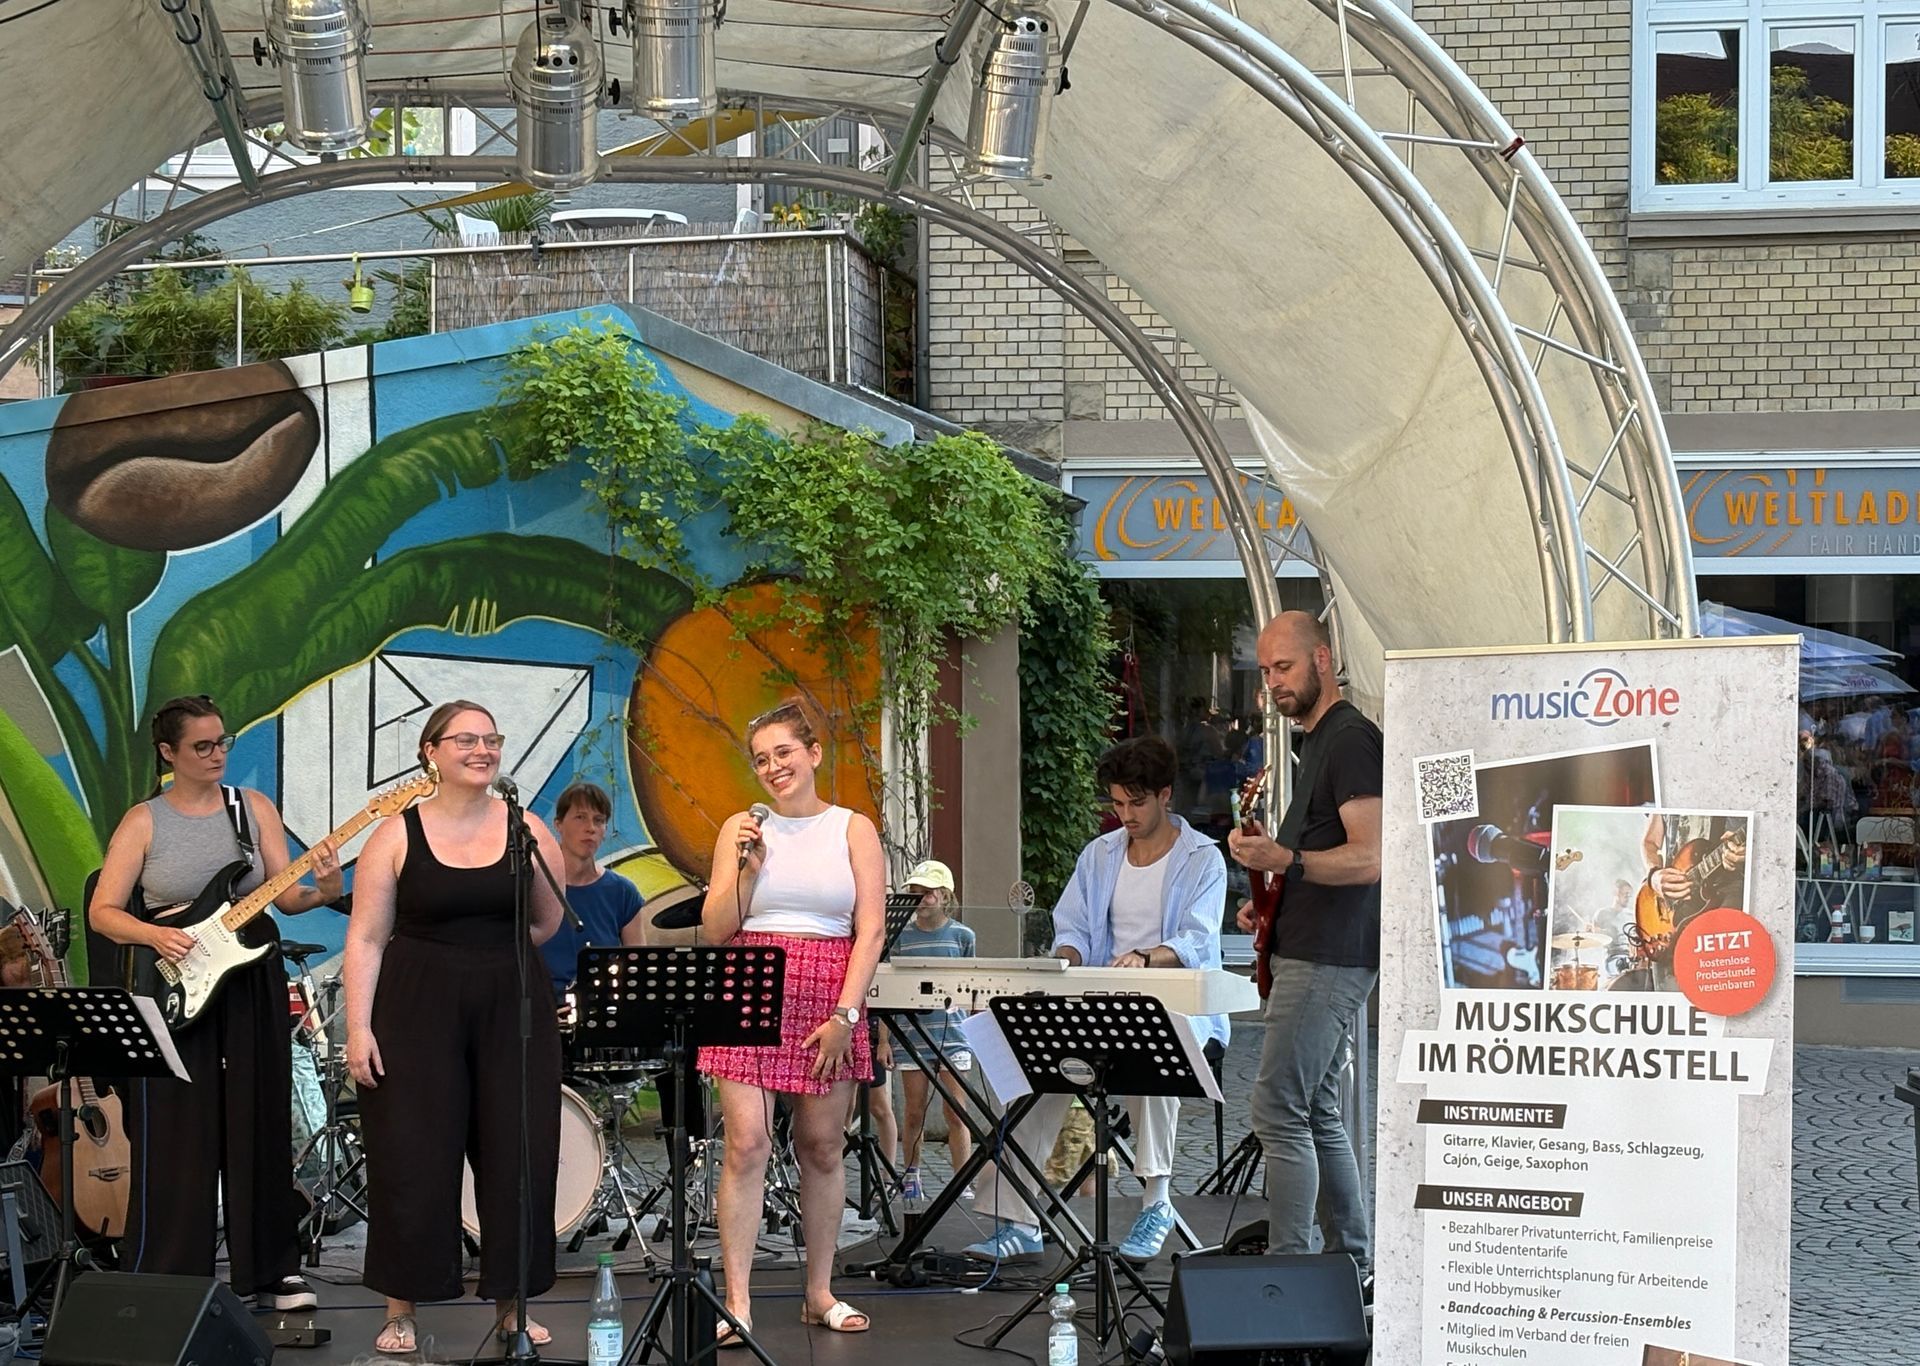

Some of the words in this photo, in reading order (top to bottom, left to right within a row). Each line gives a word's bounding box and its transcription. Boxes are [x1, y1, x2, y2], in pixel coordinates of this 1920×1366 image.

[1724, 490, 1920, 526] WELTLAD
[1810, 535, 1854, 555] FAIR
[1491, 677, 1680, 721] musicZone
[1693, 930, 1753, 953] JETZT
[1700, 956, 1750, 968] kostenlose
[1696, 967, 1756, 981] Probestunde
[1698, 980, 1755, 992] vereinbaren
[1455, 1001, 1707, 1037] MUSIKSCHULE
[1418, 1042, 1456, 1073] IM
[1466, 1037, 1749, 1082] RÖMERKASTELL
[1444, 1105, 1554, 1123] INSTRUMENTE
[1443, 1134, 1488, 1149] Gitarre,
[1491, 1136, 1536, 1151] Klavier,
[1539, 1138, 1589, 1154] Gesang,
[1593, 1140, 1624, 1154] Bass,
[1627, 1142, 1705, 1159] Schlagzeug,
[1443, 1153, 1481, 1168] Cajón,
[1484, 1155, 1523, 1170] Geige,
[1526, 1157, 1589, 1173] Saxophon
[1442, 1191, 1494, 1208] UNSER
[1497, 1194, 1572, 1212] ANGEBOT
[1448, 1221, 1519, 1238] Bezahlbarer
[1521, 1225, 1620, 1245] Privatunterricht,
[1623, 1231, 1714, 1249] Familienpreise
[1448, 1240, 1472, 1253] und
[1474, 1241, 1568, 1259] Studententarife
[1448, 1261, 1493, 1276] Flexible
[1496, 1263, 1614, 1286] Unterrichtsplanung
[1617, 1270, 1635, 1284] für
[1638, 1272, 1709, 1290] Arbeitende
[1448, 1280, 1471, 1293] und
[1474, 1281, 1562, 1299] Hobbymusiker
[1447, 1301, 1535, 1321] Bandcoaching
[1537, 1307, 1548, 1320] &
[1550, 1308, 1692, 1330] Percussion-Ensembles
[1446, 1322, 1496, 1339] Mitglied
[1498, 1325, 1514, 1339] im
[1516, 1327, 1567, 1343] Verband
[1570, 1330, 1591, 1345] der
[1593, 1332, 1630, 1347] freien
[1446, 1340, 1527, 1359] Musikschulen
